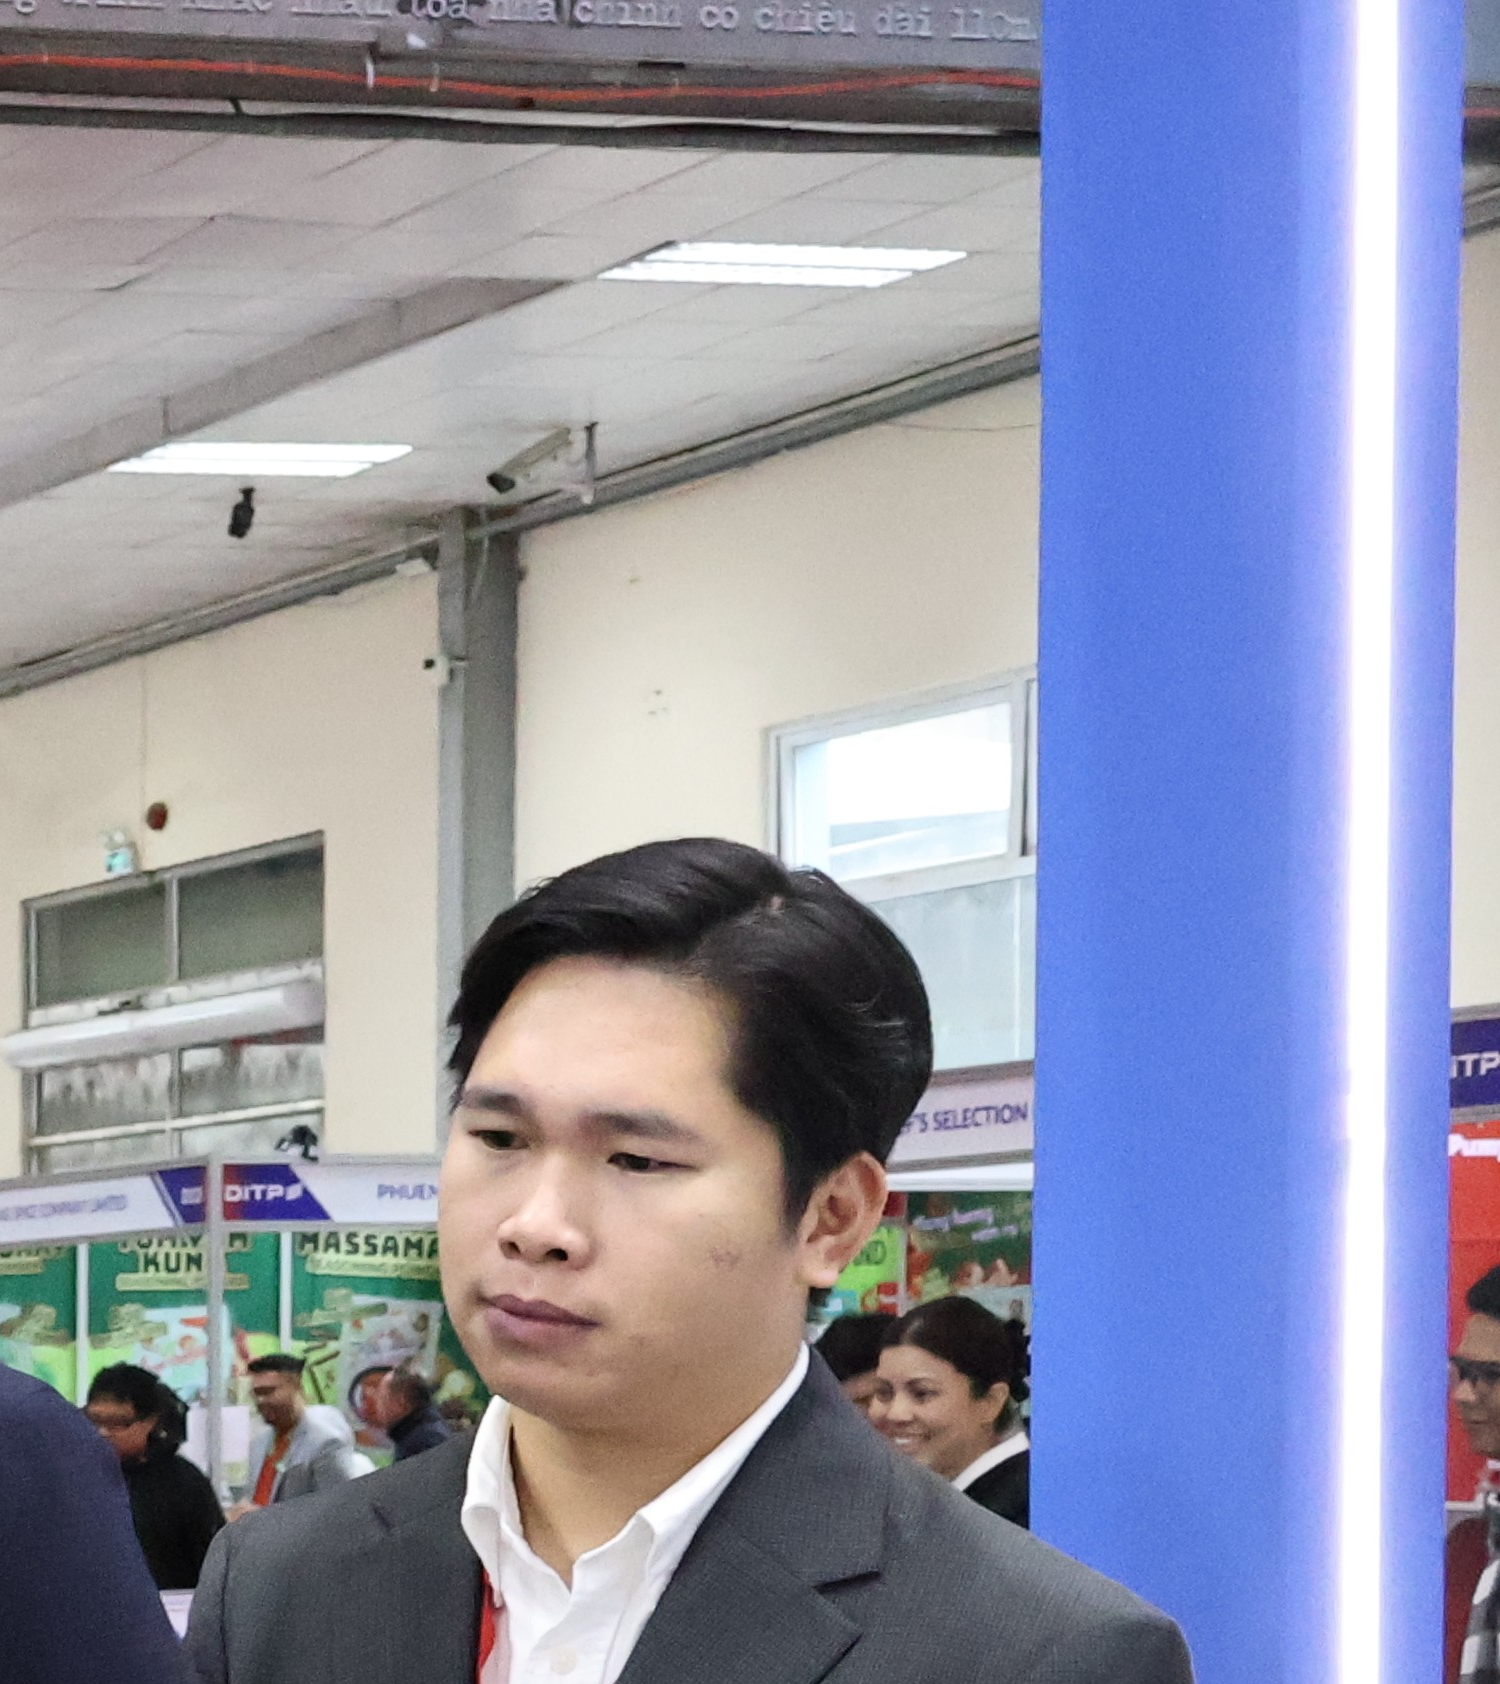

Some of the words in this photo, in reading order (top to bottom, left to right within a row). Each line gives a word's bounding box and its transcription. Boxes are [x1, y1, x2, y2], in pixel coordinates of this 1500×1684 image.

[1451, 1051, 1500, 1078] ITP
[933, 1102, 1029, 1132] SELECTION
[224, 1184, 284, 1203] DITP
[300, 1231, 438, 1258] MASSAMA
[142, 1252, 203, 1274] KUN
